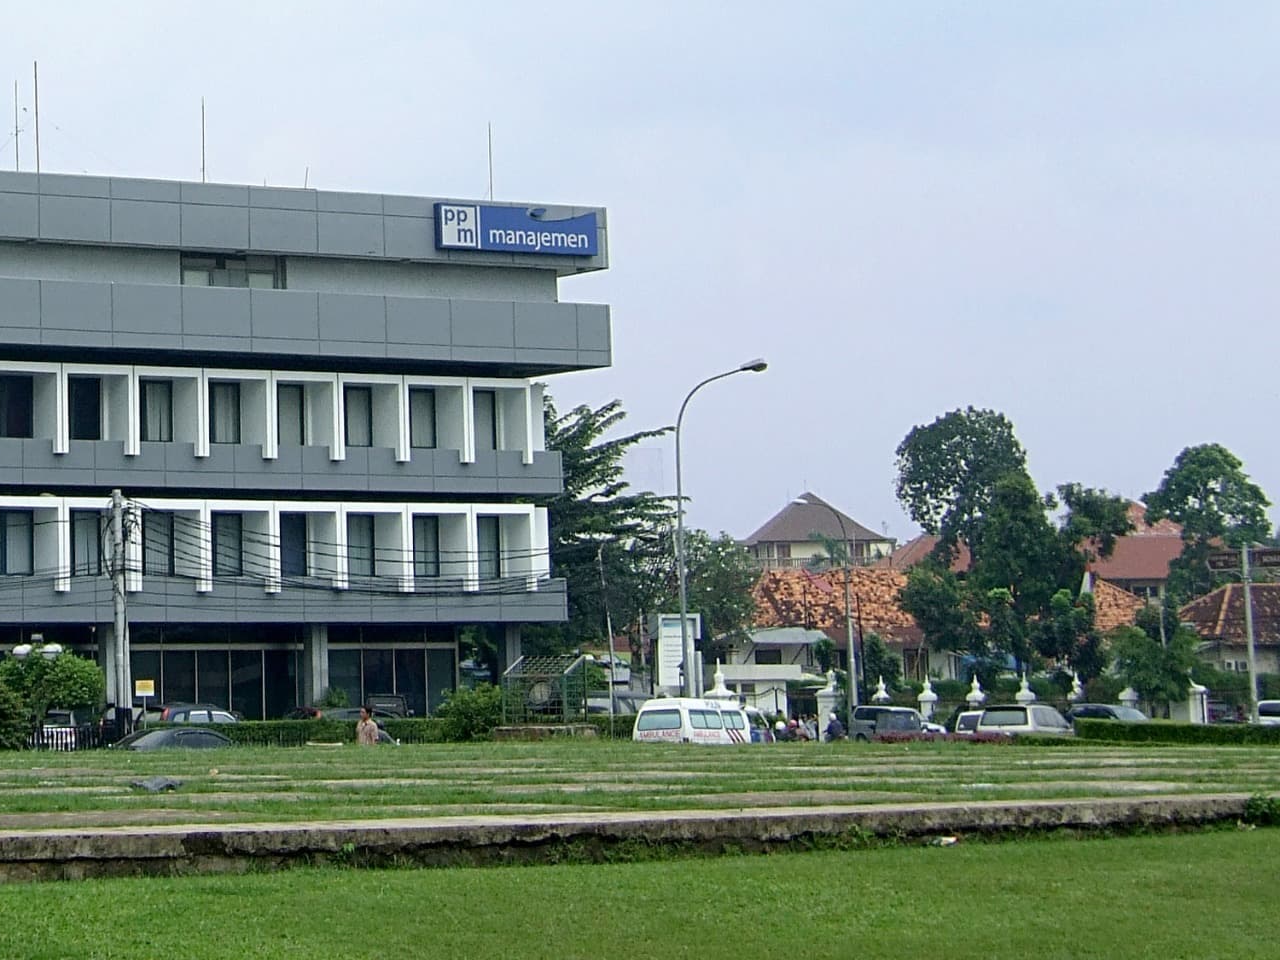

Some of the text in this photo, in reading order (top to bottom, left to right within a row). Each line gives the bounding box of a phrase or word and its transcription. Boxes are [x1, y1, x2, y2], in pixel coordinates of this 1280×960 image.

[443, 207, 468, 225] pp
[457, 227, 474, 244] m
[489, 228, 589, 250] manajemen
